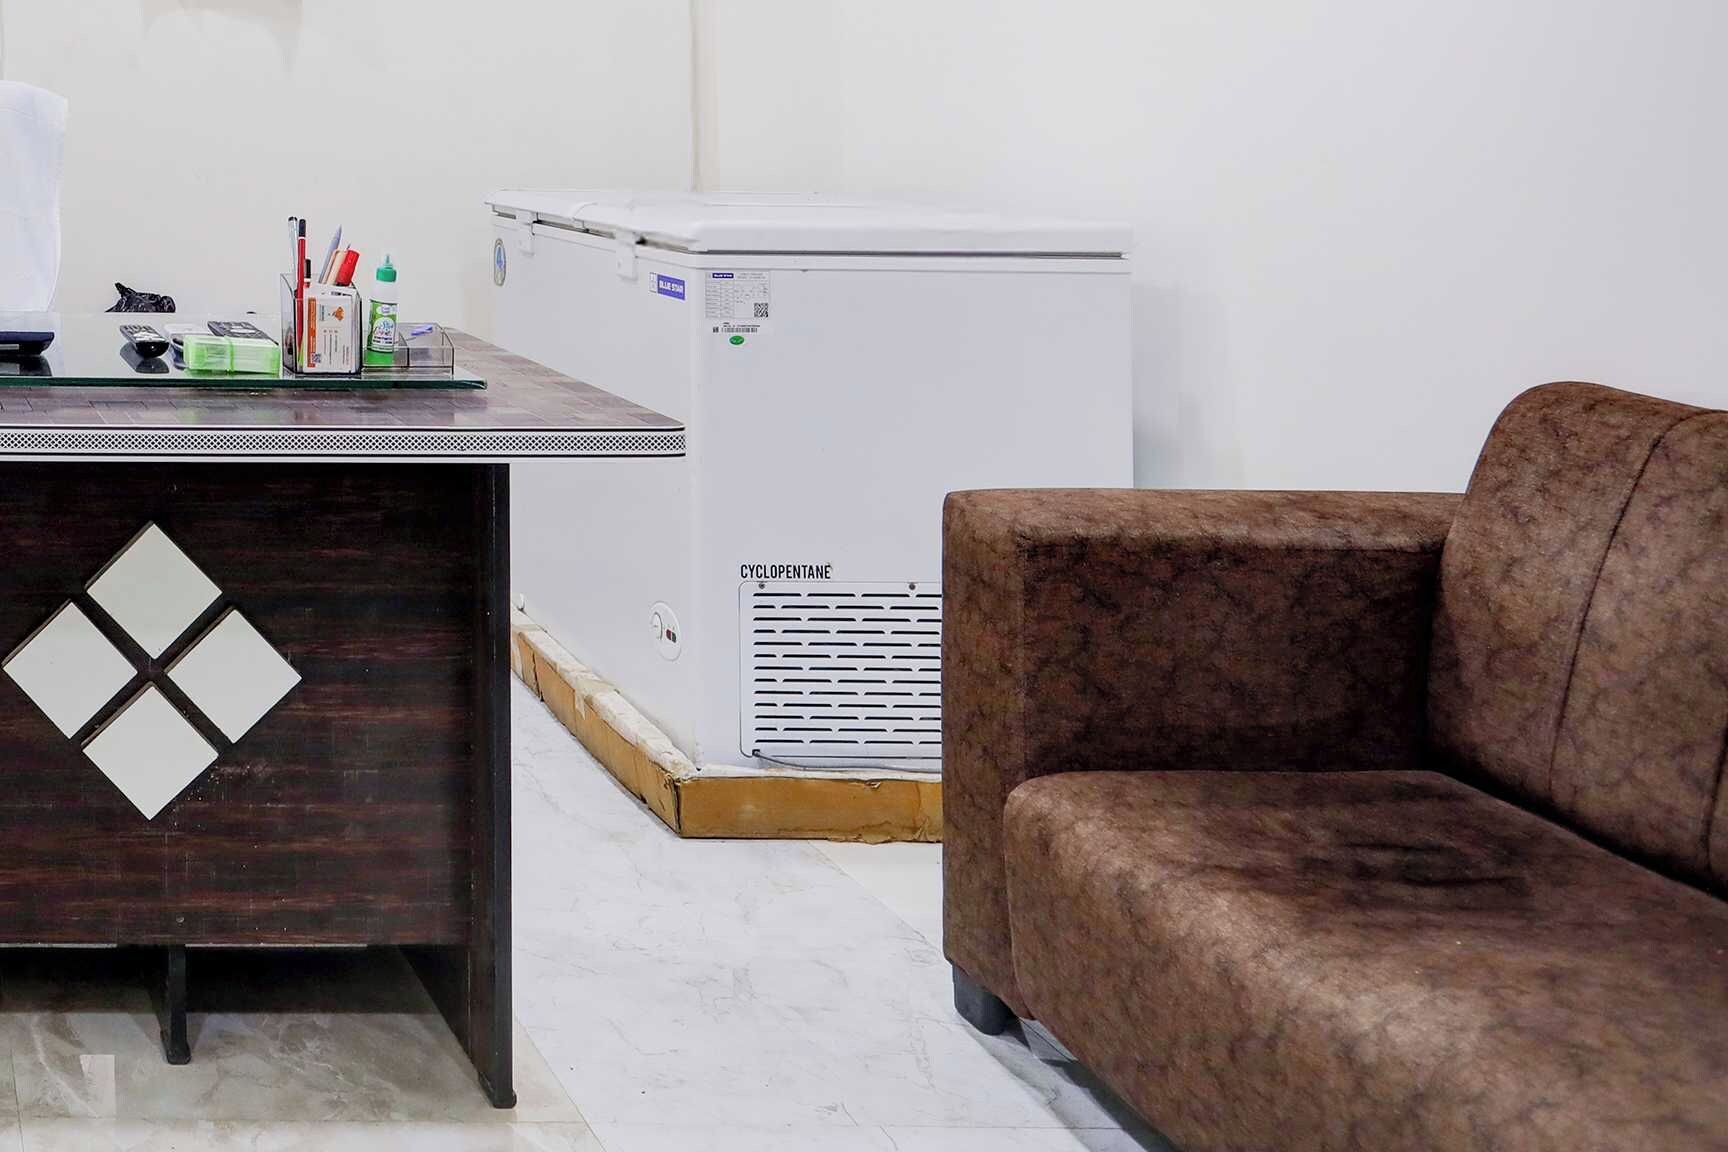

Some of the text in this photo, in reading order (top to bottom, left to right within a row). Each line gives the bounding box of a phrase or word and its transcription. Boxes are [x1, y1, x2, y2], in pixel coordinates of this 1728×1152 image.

[659, 279, 684, 294] BLUE STAR
[740, 564, 831, 579] CYCLOPENTANE
